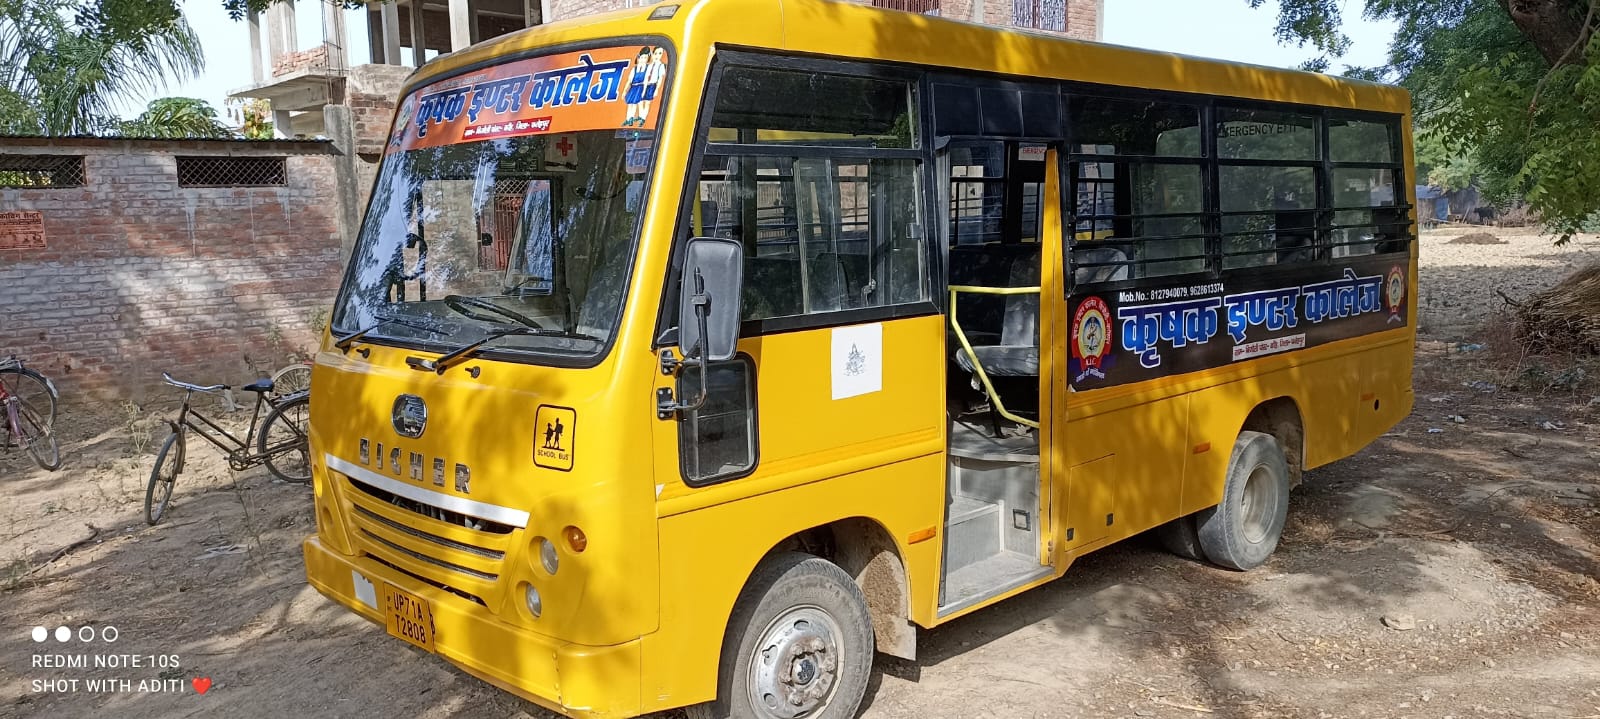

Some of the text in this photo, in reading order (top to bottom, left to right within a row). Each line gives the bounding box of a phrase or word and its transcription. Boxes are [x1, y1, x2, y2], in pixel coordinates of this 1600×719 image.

[415, 53, 632, 138] कृषक इण्टर कालेज
[1118, 297, 1222, 369] कृषक
[1224, 286, 1301, 344] इण्टर
[1302, 267, 1384, 324] कालेज
[359, 438, 471, 494] EICHER
[537, 449, 569, 461] SCHOOL BUS
[393, 591, 424, 622] UP71A
[395, 614, 426, 644] T2808
